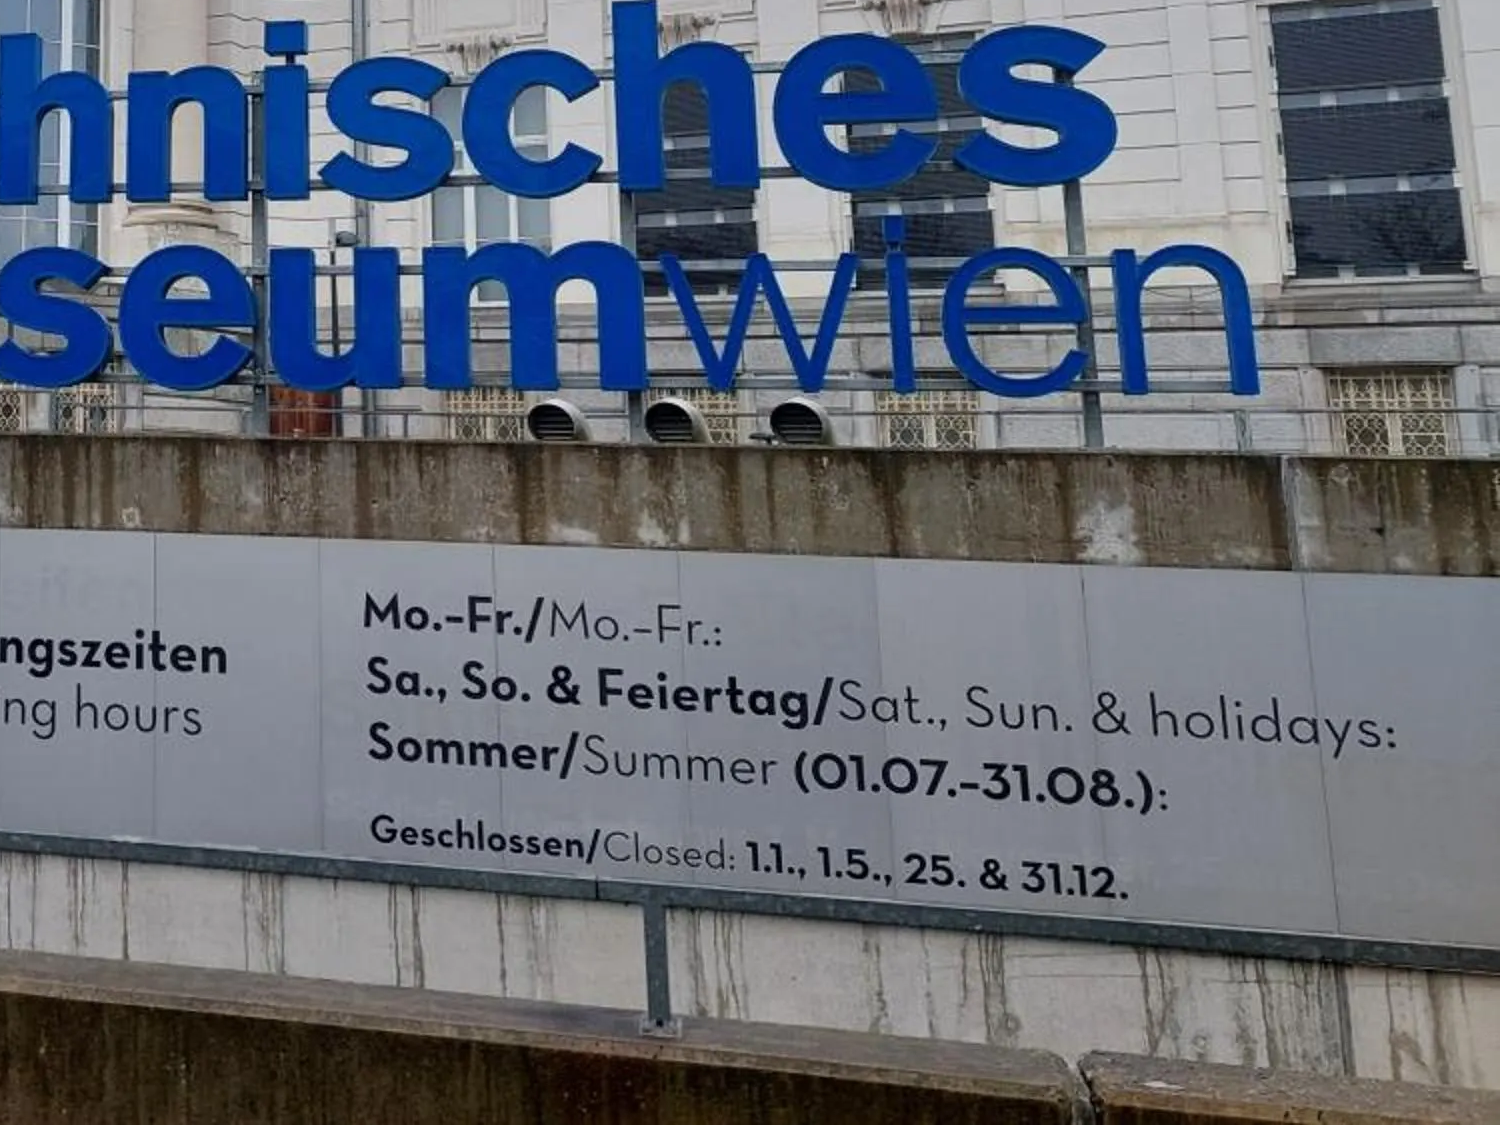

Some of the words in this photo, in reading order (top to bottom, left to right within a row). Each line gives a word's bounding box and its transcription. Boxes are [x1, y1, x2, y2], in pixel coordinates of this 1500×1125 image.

[363, 592, 722, 647] Mo.-Fr./Mo.-Fr.:
[76, 683, 203, 736] hours
[366, 656, 447, 704] Sa.,
[462, 660, 531, 703] So.
[546, 665, 581, 706] &
[597, 666, 947, 731] Feiertag/Sat.,
[965, 686, 1073, 732] Sun.
[1091, 691, 1132, 736] &
[1149, 691, 1397, 760] holidays:
[368, 721, 778, 786] Sommer/Summer
[794, 751, 1169, 816] (01.07.-31.08.):
[370, 814, 735, 871] Geschlossen/Closed:
[816, 846, 893, 888] 1.5.,
[903, 852, 966, 888] 25.
[979, 858, 1009, 891] &
[1021, 860, 1129, 900] 31.12.
